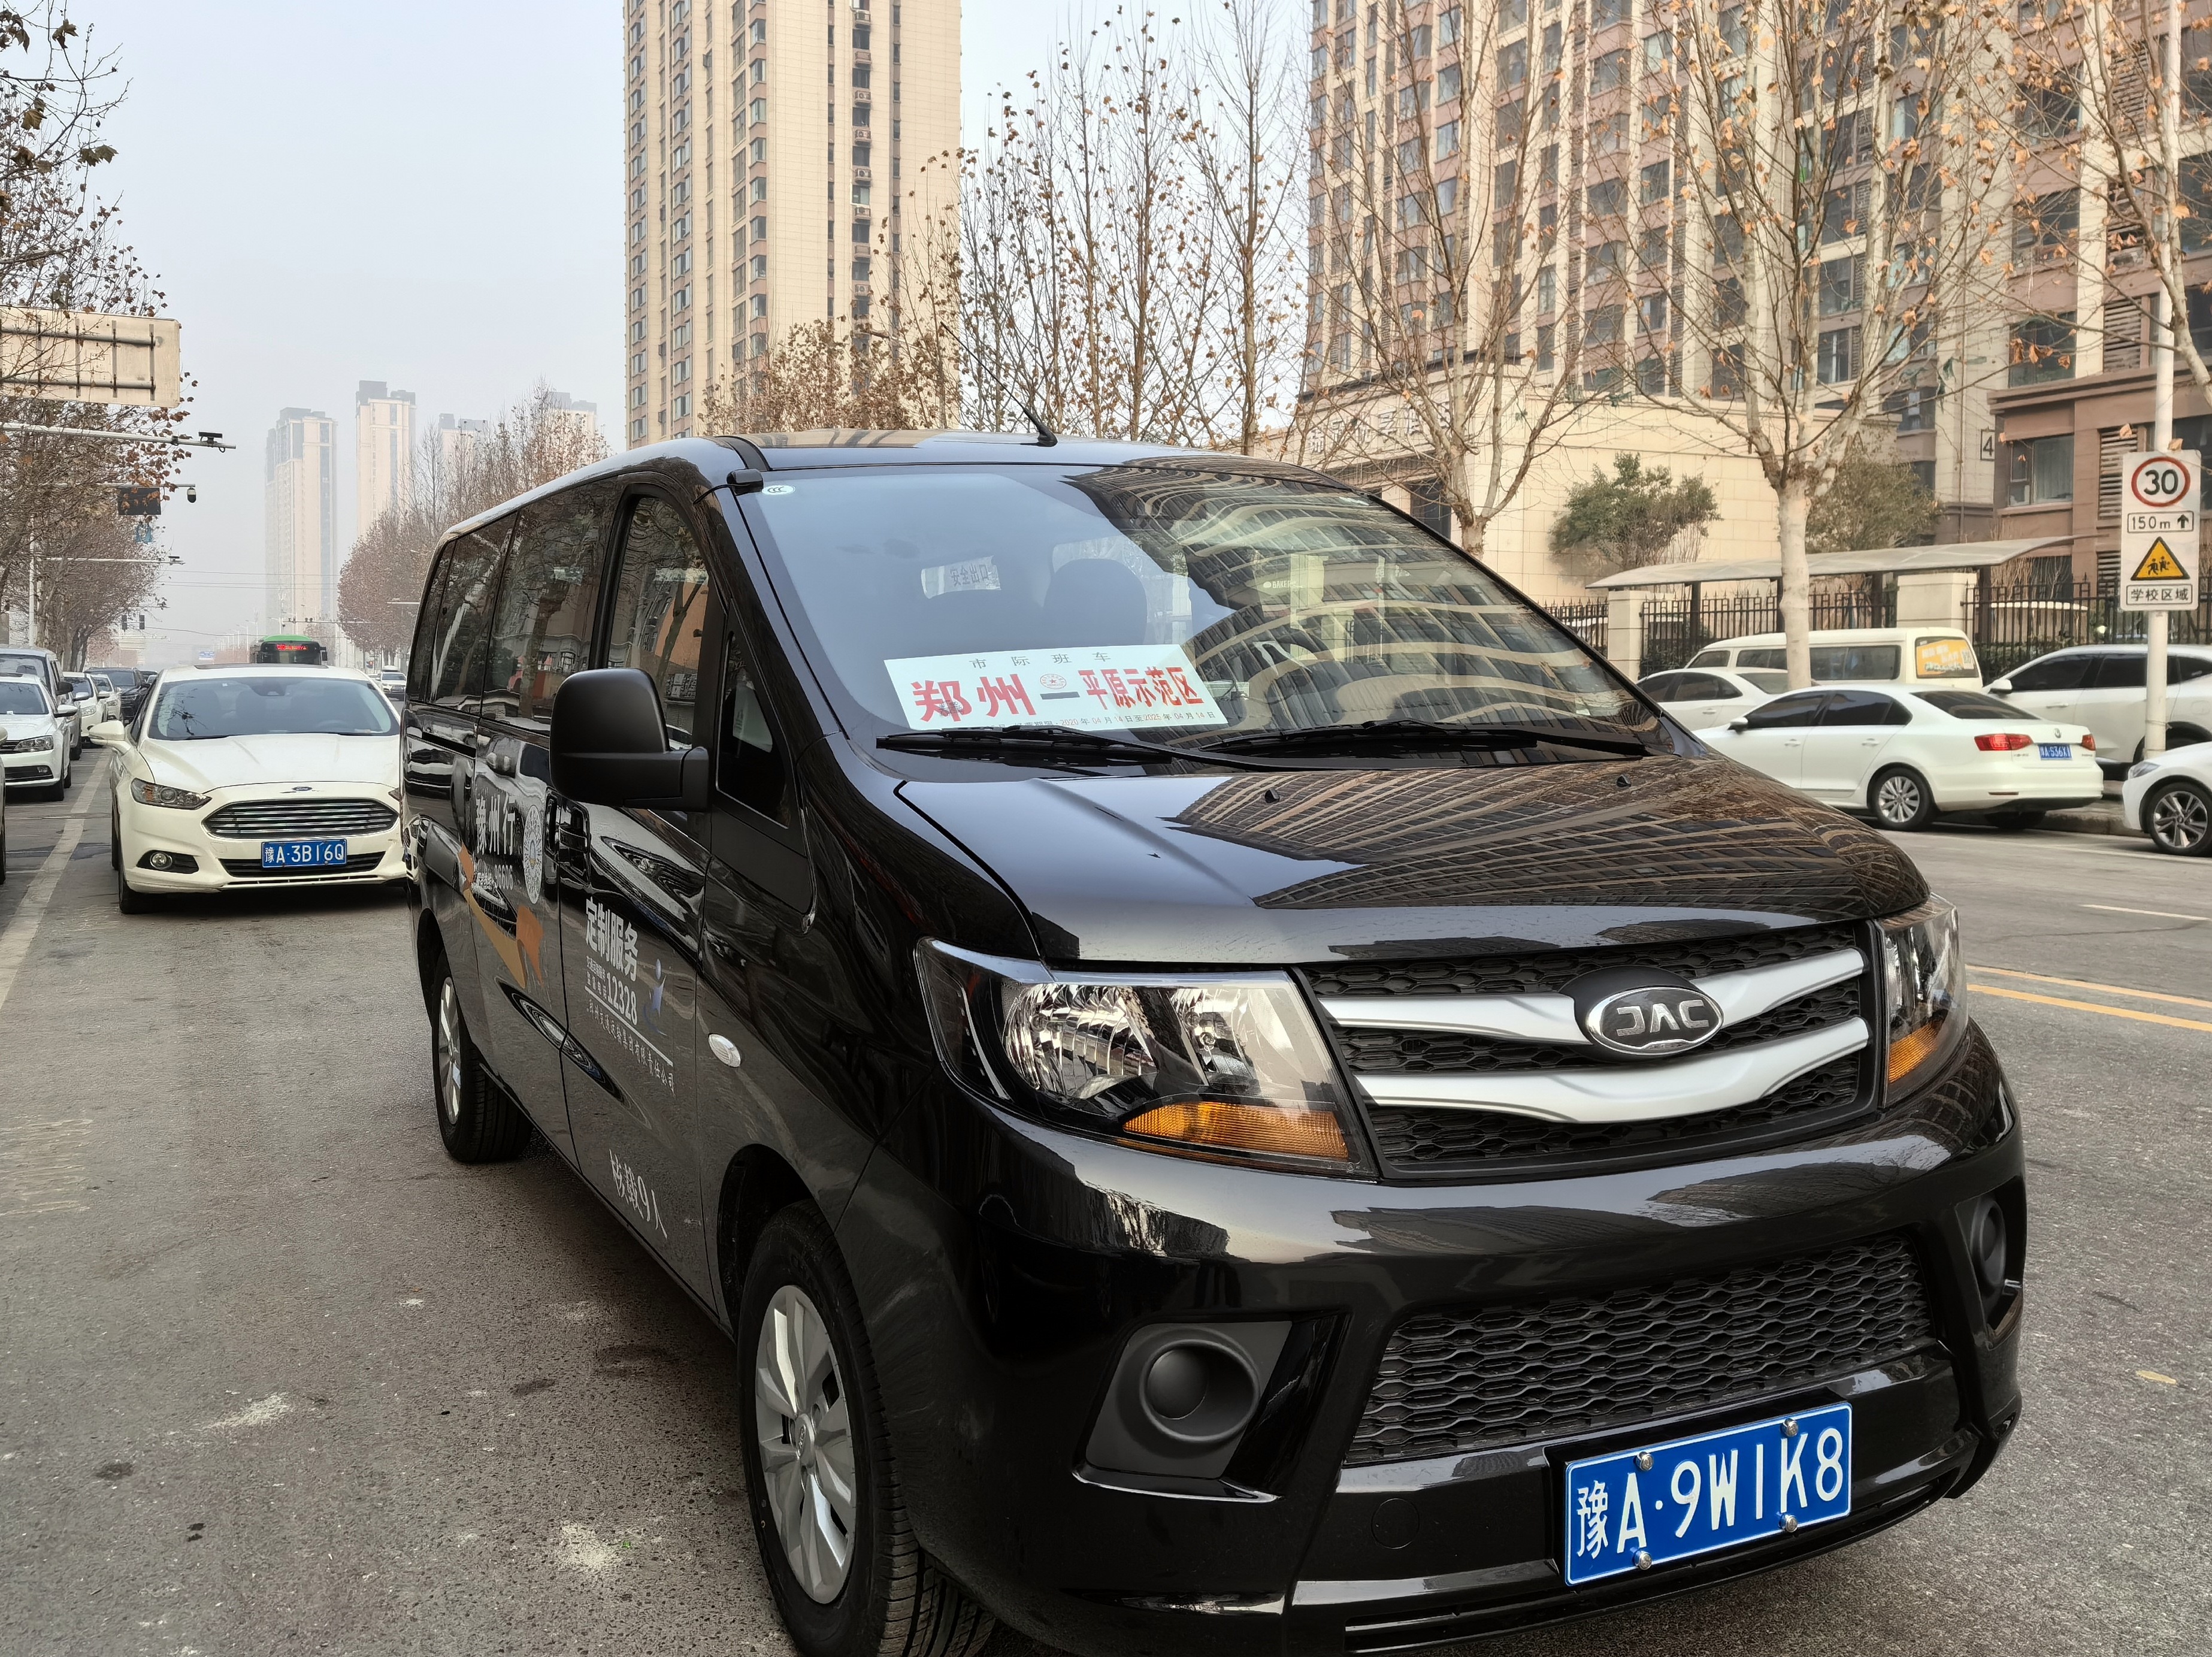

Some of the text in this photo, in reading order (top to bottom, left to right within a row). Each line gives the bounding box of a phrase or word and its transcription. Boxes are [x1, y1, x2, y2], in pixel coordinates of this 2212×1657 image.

[1983, 435, 1994, 456] 4
[2144, 469, 2178, 495] 30
[2131, 516, 2171, 530] 150m
[950, 563, 990, 587] 安全出口
[2131, 588, 2189, 601] 学校区域
[969, 651, 1111, 669] 市际班车
[1078, 666, 1205, 710] 平原示范区
[585, 896, 639, 982] 定制服务
[607, 972, 637, 1026] 12328
